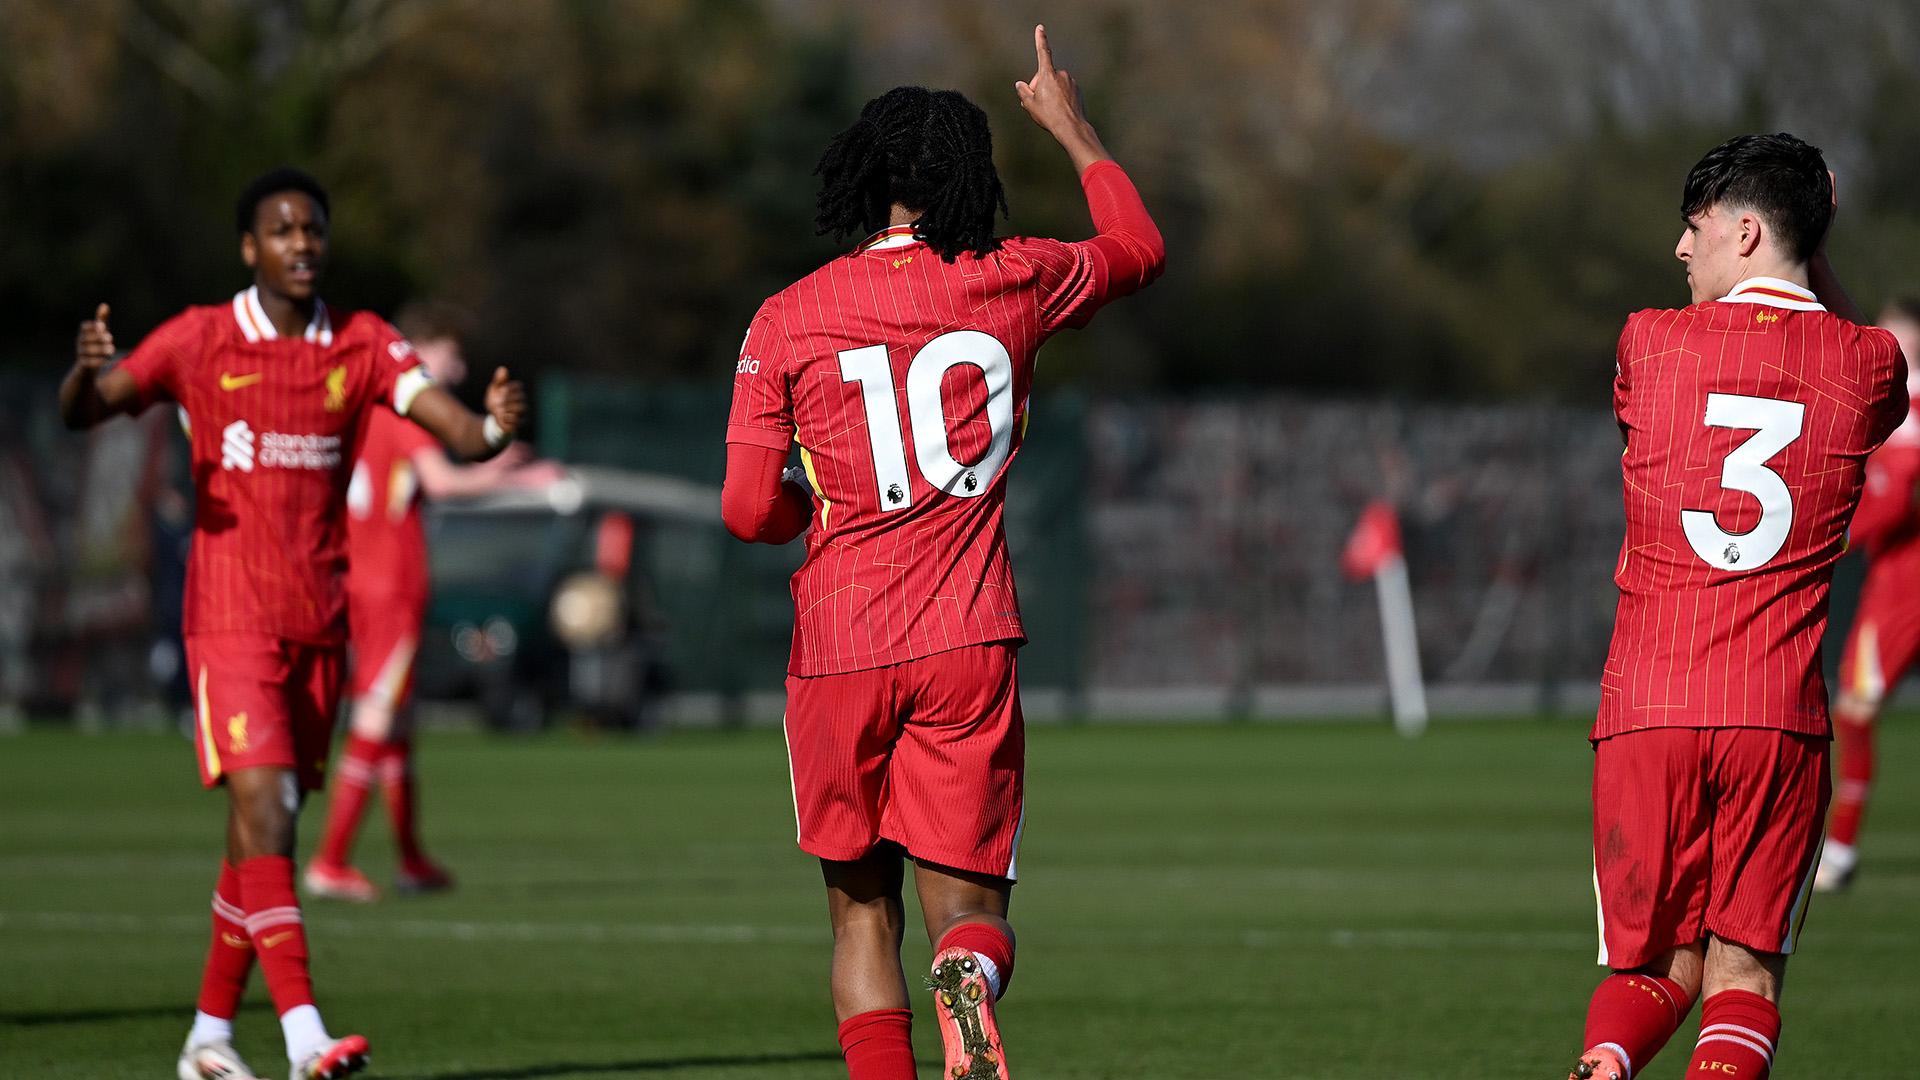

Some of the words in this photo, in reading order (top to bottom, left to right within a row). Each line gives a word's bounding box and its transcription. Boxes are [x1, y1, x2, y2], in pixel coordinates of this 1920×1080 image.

[838, 330, 1014, 512] 10
[1681, 392, 1806, 571] 3
[1699, 1060, 1738, 1075] LFC
